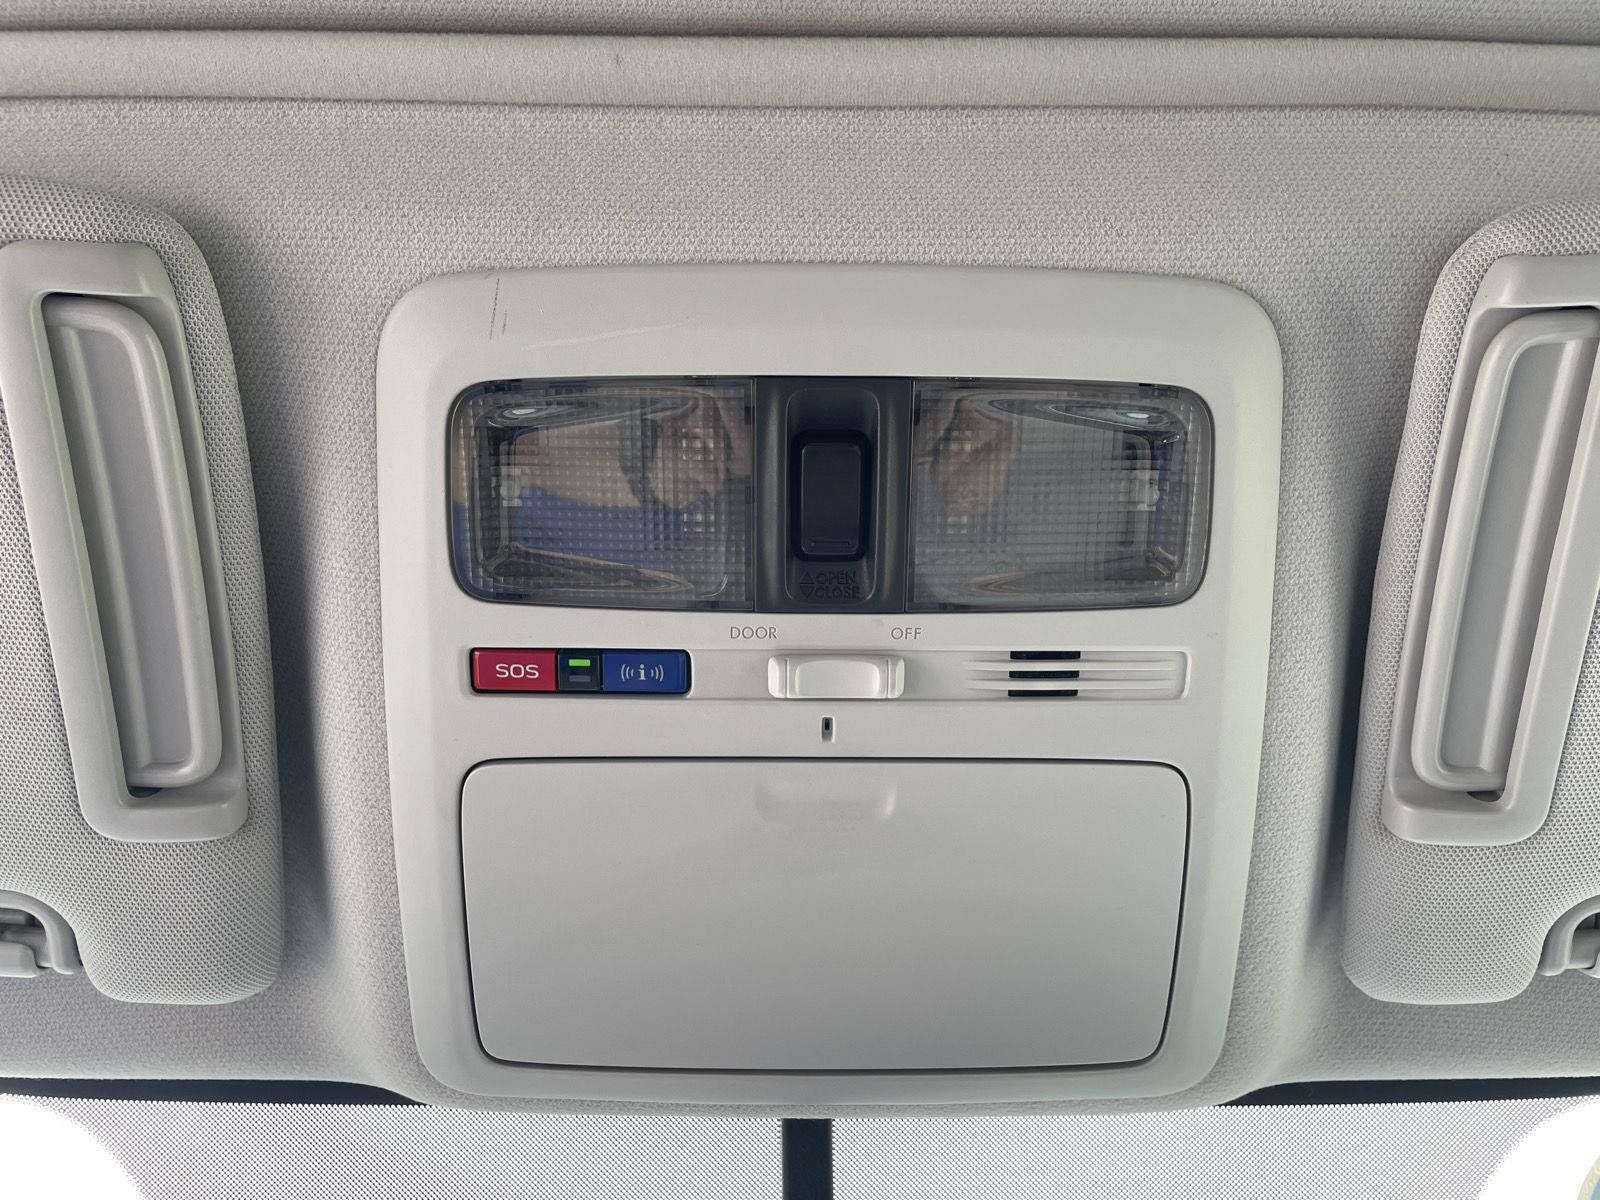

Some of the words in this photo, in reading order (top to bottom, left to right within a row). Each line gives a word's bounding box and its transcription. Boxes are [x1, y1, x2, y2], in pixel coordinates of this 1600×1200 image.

[816, 571, 856, 585] OPEN
[815, 585, 860, 599] CLOSE
[730, 626, 778, 639] DOOR
[891, 627, 922, 640] OFF
[495, 663, 540, 679] SOS
